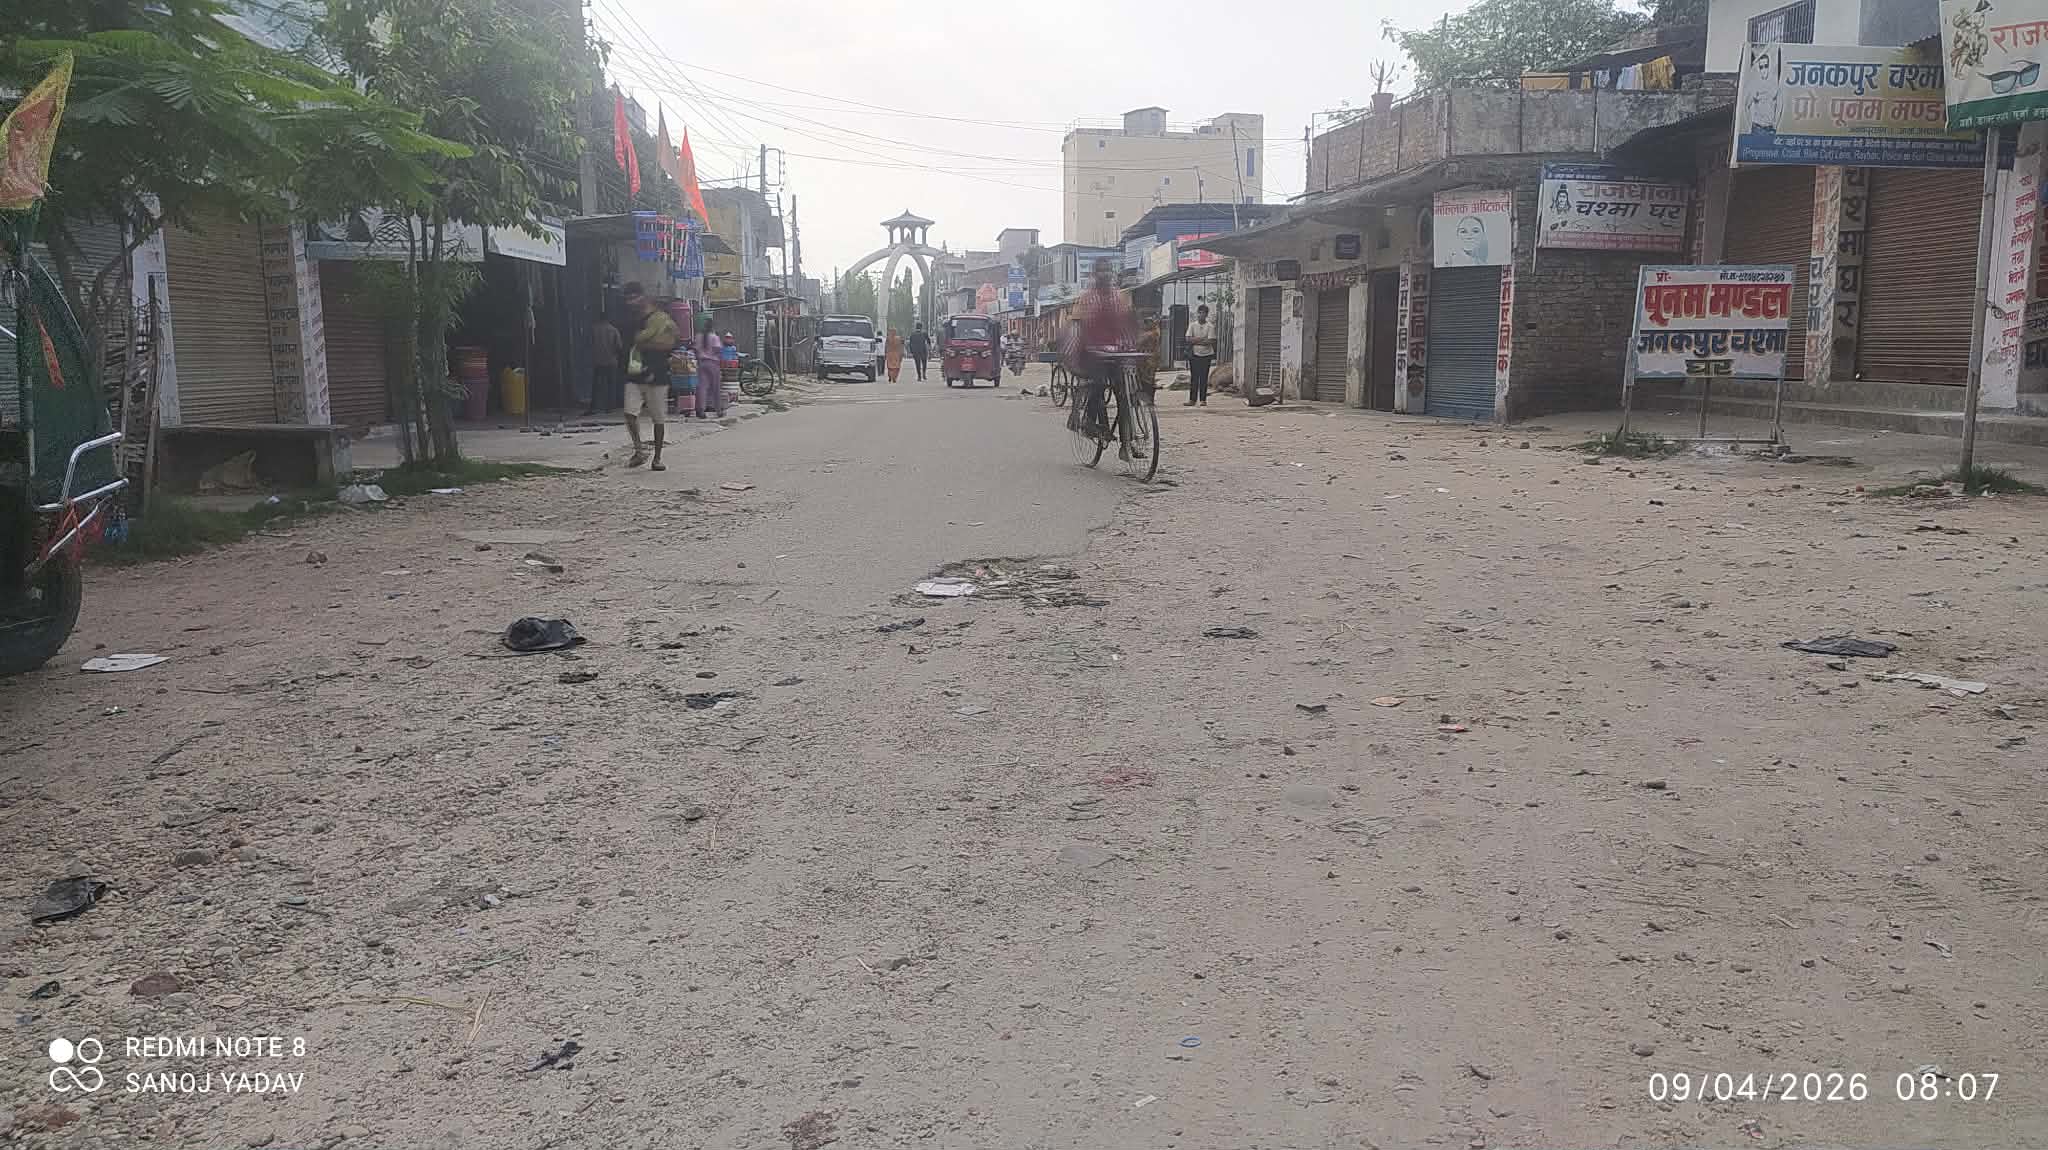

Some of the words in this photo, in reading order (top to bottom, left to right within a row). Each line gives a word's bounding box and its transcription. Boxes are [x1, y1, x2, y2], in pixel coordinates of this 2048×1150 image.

[1785, 61, 1882, 95] जनकपुर
[1830, 97, 1882, 127] पूनम
[1890, 98, 1946, 122] मण्ड
[1575, 200, 1640, 217] चश्मा
[1649, 203, 1681, 220] घर
[1644, 284, 1709, 327] पूनम
[1709, 284, 1792, 319] मण्डल
[1637, 329, 1731, 358] जनकपुर
[1731, 329, 1788, 355] चश्मा
